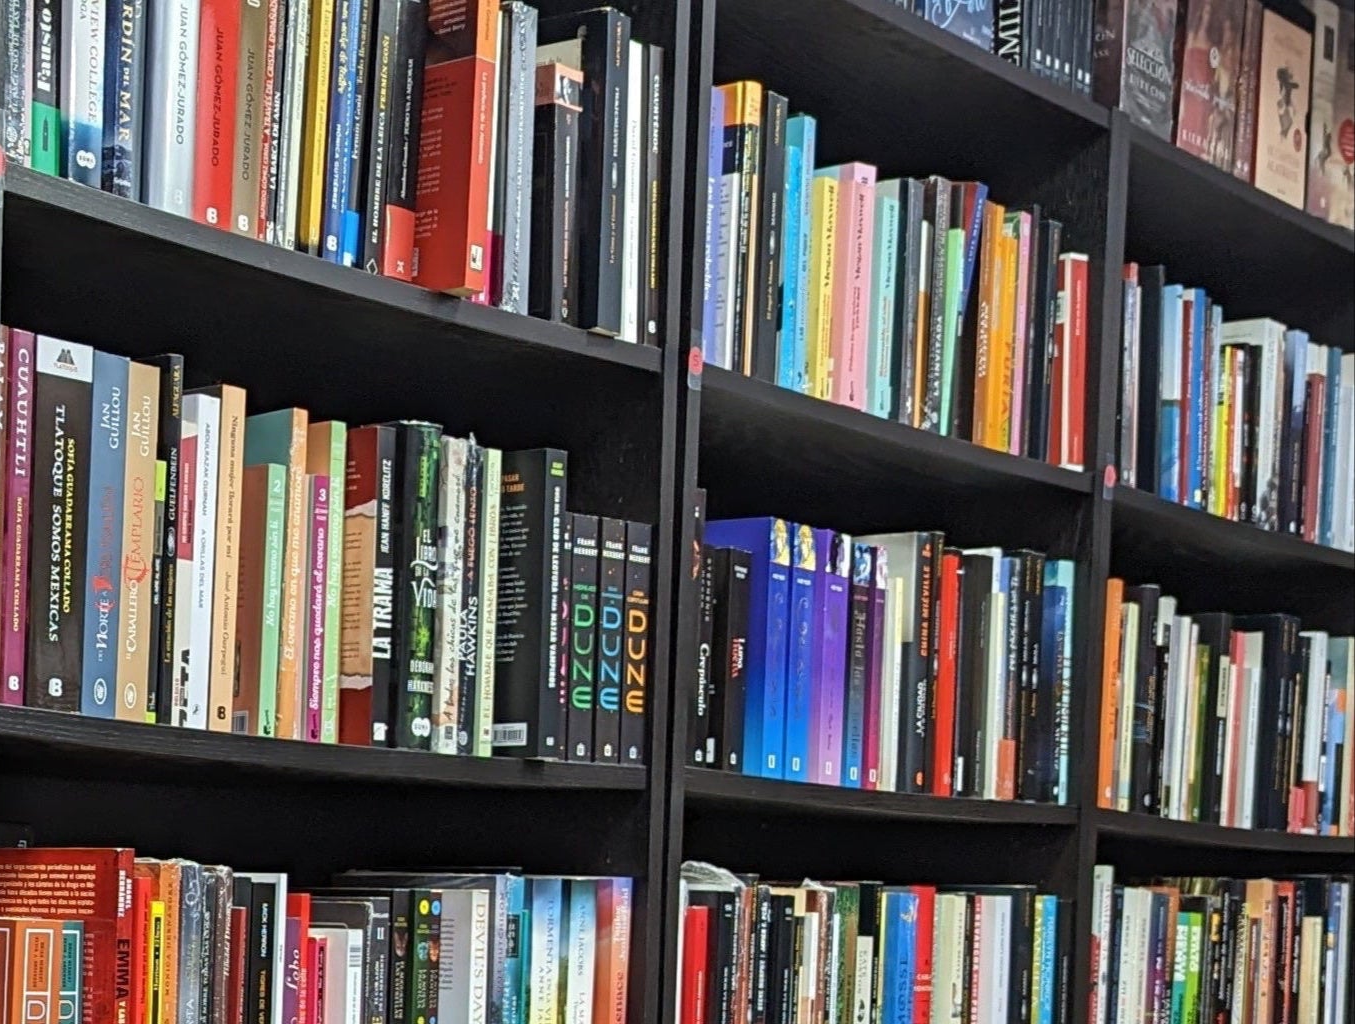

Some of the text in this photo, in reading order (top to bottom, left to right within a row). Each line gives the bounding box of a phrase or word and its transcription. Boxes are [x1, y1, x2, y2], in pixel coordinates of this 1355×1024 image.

[36, 8, 52, 91] Fausto
[211, 27, 223, 167] JUAN GÓMEZ-JURADO
[933, 315, 942, 376] INVITADA
[14, 348, 29, 476] CUAUHTLI
[101, 403, 110, 428] JAN
[109, 386, 121, 449] GUILLOU
[48, 405, 66, 642] TLATOQUE SOMOS MEXICAS
[371, 568, 394, 659] LA TRAMA
[465, 596, 478, 676] HAWKINS
[572, 603, 594, 710] DUNE
[599, 606, 621, 711] DUNE
[626, 608, 646, 714] DUNE
[697, 643, 709, 717] Crepúsculo
[116, 938, 130, 1000] EMMA
